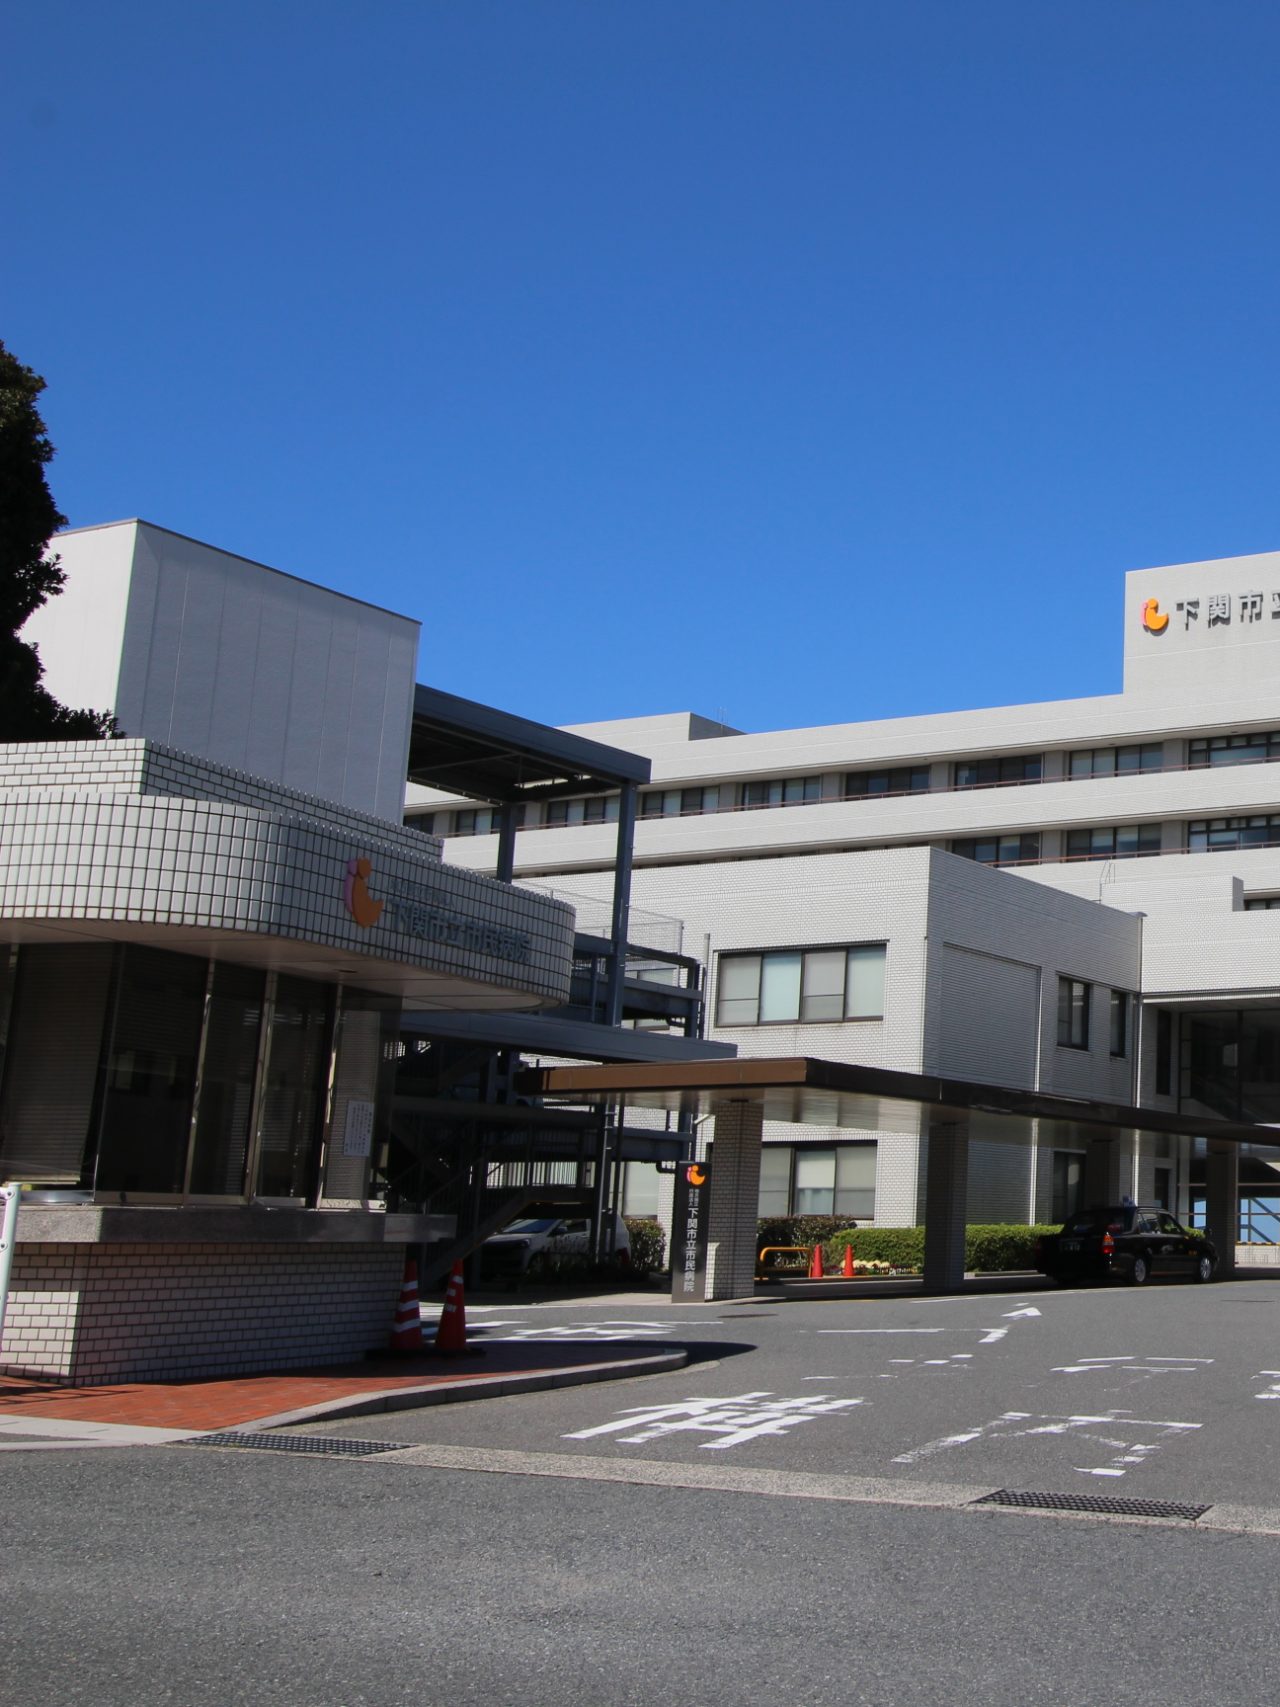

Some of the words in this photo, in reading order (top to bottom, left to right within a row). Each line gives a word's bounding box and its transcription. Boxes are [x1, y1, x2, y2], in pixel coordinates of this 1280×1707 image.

[389, 896, 531, 964] 下関市立市民病院
[683, 1207, 700, 1293] 下関市立市民病院
